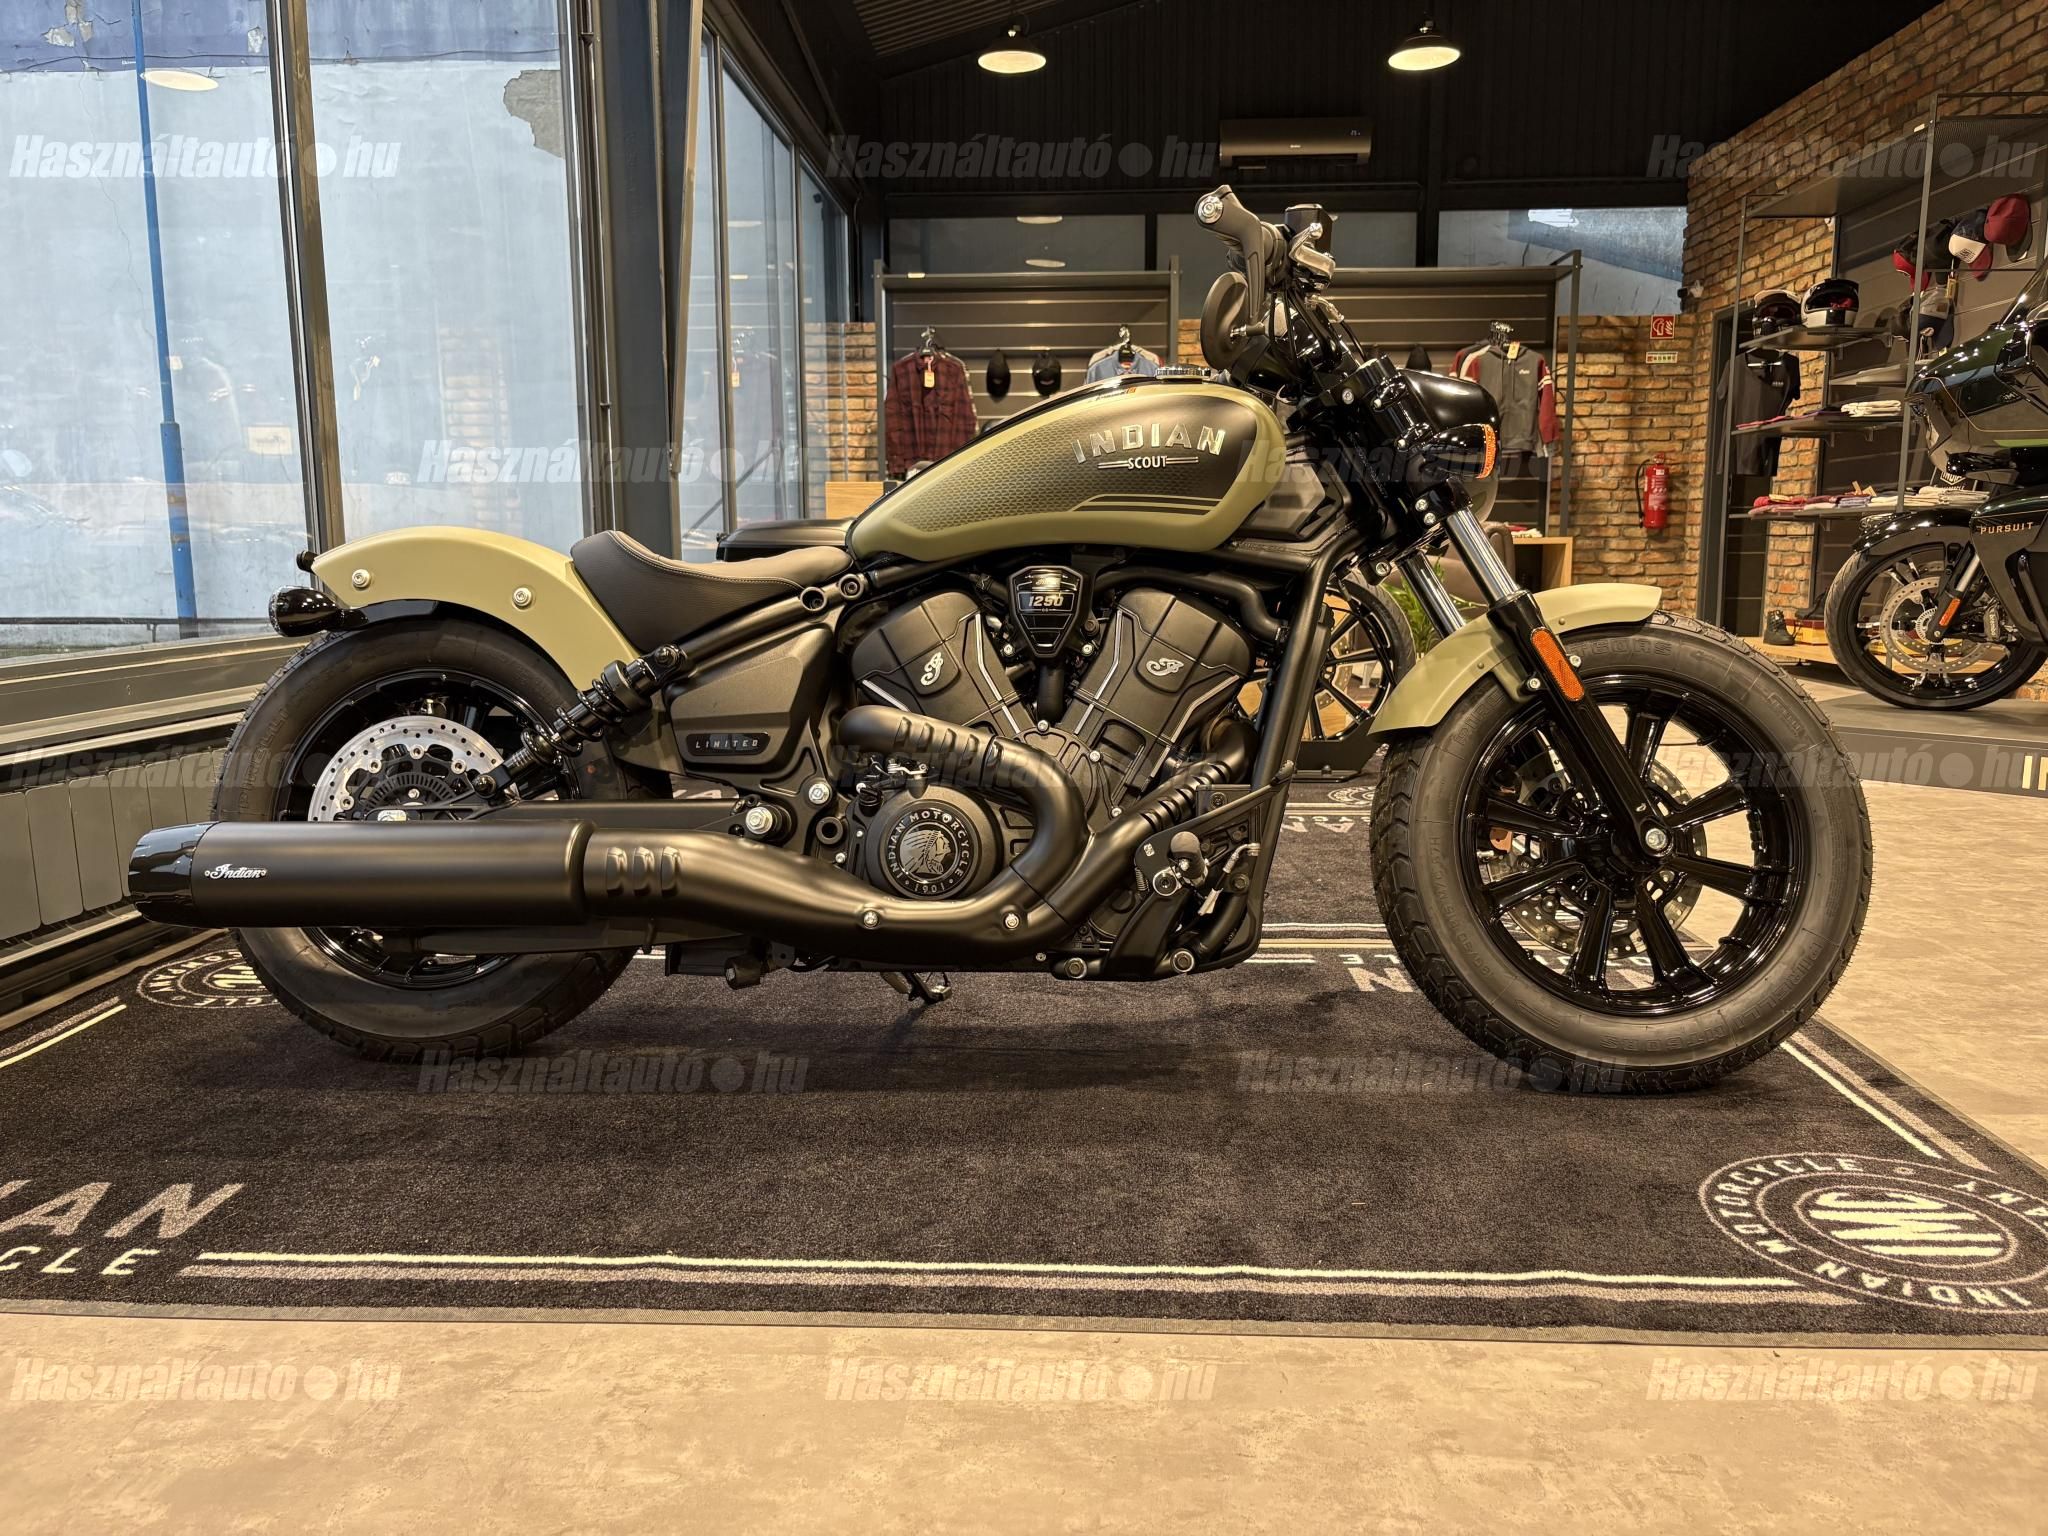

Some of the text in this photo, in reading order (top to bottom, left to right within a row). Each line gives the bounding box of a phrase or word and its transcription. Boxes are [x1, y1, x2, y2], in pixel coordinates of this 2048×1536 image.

[1071, 423, 1226, 464] INDIAN
[1127, 455, 1168, 470] SCOUT
[1980, 521, 2034, 535] PURSUIT
[1028, 595, 1064, 607] 1250
[695, 739, 759, 749] LIMITED
[888, 810, 970, 878] INDIAN MOTORCYCLE
[204, 863, 268, 879] Indian
[914, 882, 946, 893] 1901
[1713, 1157, 2032, 1307] INDIAN MOTORCYCLE
